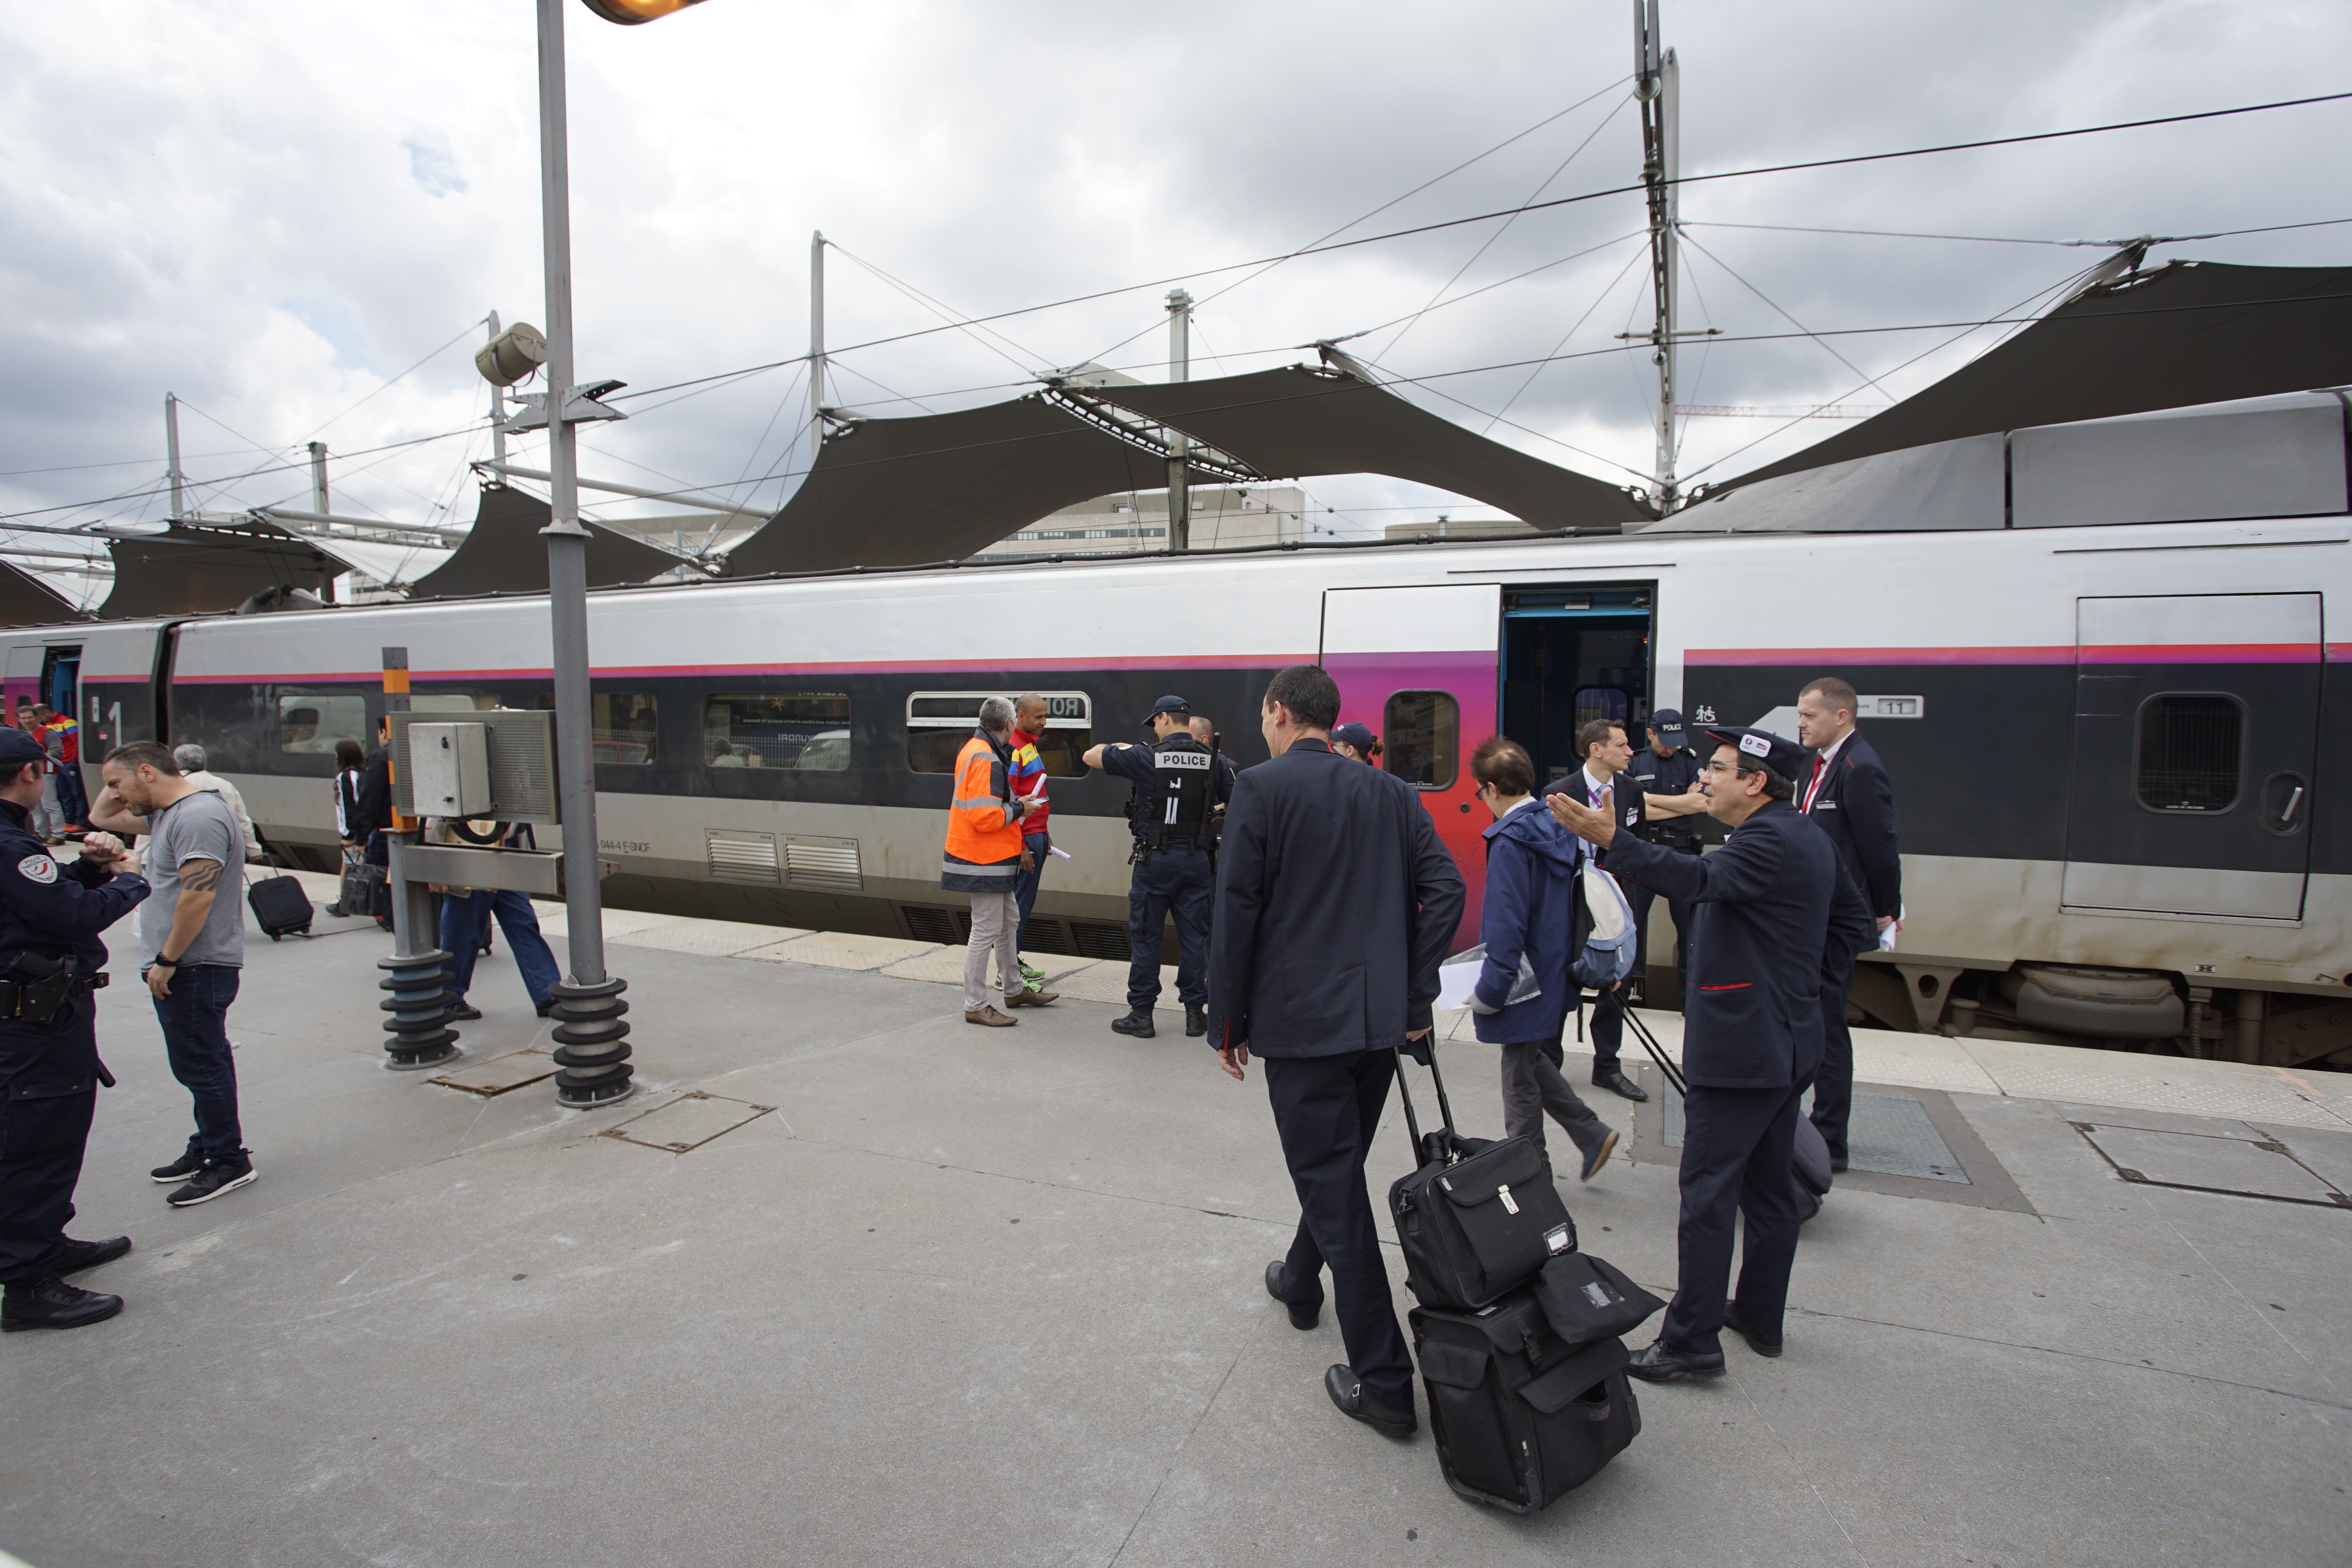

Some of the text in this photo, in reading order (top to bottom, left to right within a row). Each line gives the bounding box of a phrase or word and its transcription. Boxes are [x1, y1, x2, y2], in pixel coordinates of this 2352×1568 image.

[1887, 702, 1903, 714] 11
[1163, 755, 1206, 766] POLICE
[600, 840, 650, 853] 044-4 F-SNCF
[22, 858, 48, 869] NATIONALE
[24, 856, 41, 864] POLICE
